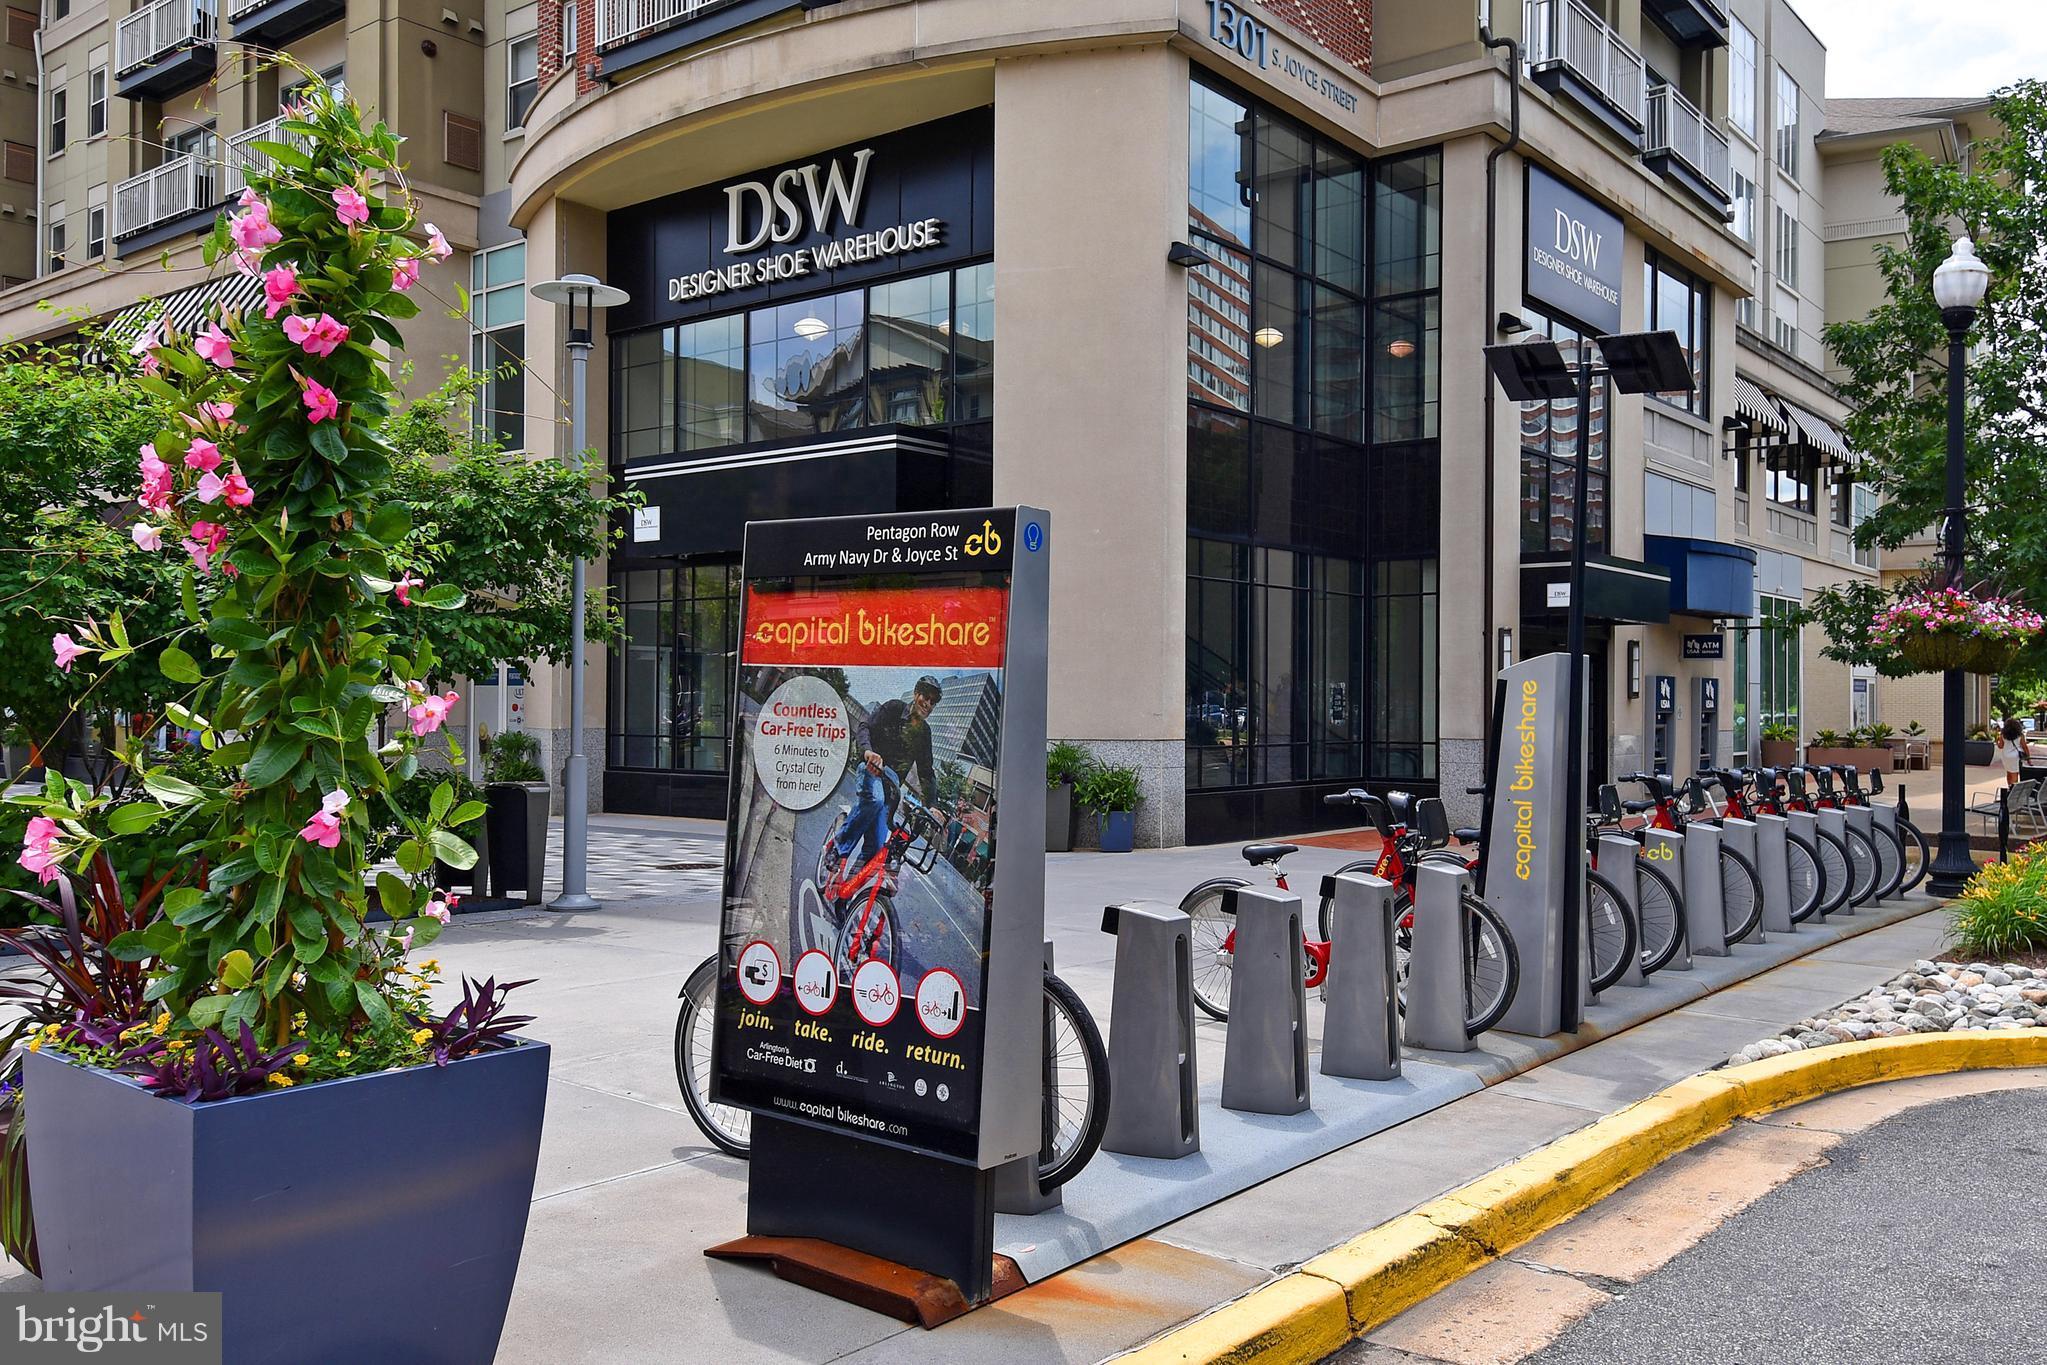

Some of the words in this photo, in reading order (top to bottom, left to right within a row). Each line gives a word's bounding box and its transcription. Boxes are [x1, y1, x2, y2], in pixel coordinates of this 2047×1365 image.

[1206, 0, 1269, 71] 1301
[1284, 55, 1318, 91] JOYCE
[1320, 78, 1357, 114] STREET
[722, 148, 875, 254] DSW
[1554, 208, 1602, 271] DSW
[668, 262, 753, 301] DESIGNER
[756, 249, 807, 283] SHOE
[811, 217, 941, 270] WAREHOUSE
[1533, 247, 1565, 277] DESIGNER
[1565, 264, 1582, 286] SHOE
[1584, 273, 1618, 306] WAREHOUSE
[867, 524, 927, 543] Pentagon
[930, 523, 960, 537] Row
[804, 552, 836, 569] Army
[839, 550, 870, 566] Navy
[873, 549, 888, 564] Dr
[891, 548, 902, 563] &
[905, 546, 941, 564] Joyce
[944, 545, 958, 561] St
[757, 613, 850, 652] capital
[857, 608, 990, 646] bikeshare
[1702, 641, 1719, 649] ATM
[773, 702, 837, 719] Countless
[761, 720, 814, 738] Car-Free
[816, 723, 846, 742] Trips
[1510, 679, 1538, 792] bikeshare
[774, 744, 780, 755] 6
[782, 744, 818, 757] Minutes
[820, 747, 829, 758] to
[775, 761, 805, 775] Crystal
[807, 762, 825, 777] City
[776, 777, 797, 790] from
[799, 778, 821, 792] here!
[1512, 800, 1537, 881] capital
[738, 1008, 774, 1031] join.
[794, 1018, 833, 1043] take.
[851, 1031, 889, 1054] ride.
[906, 1043, 965, 1070] return.
[760, 1041, 789, 1054] Arlington's
[746, 1047, 784, 1065] Car-Free
[785, 1055, 803, 1070] Diet
